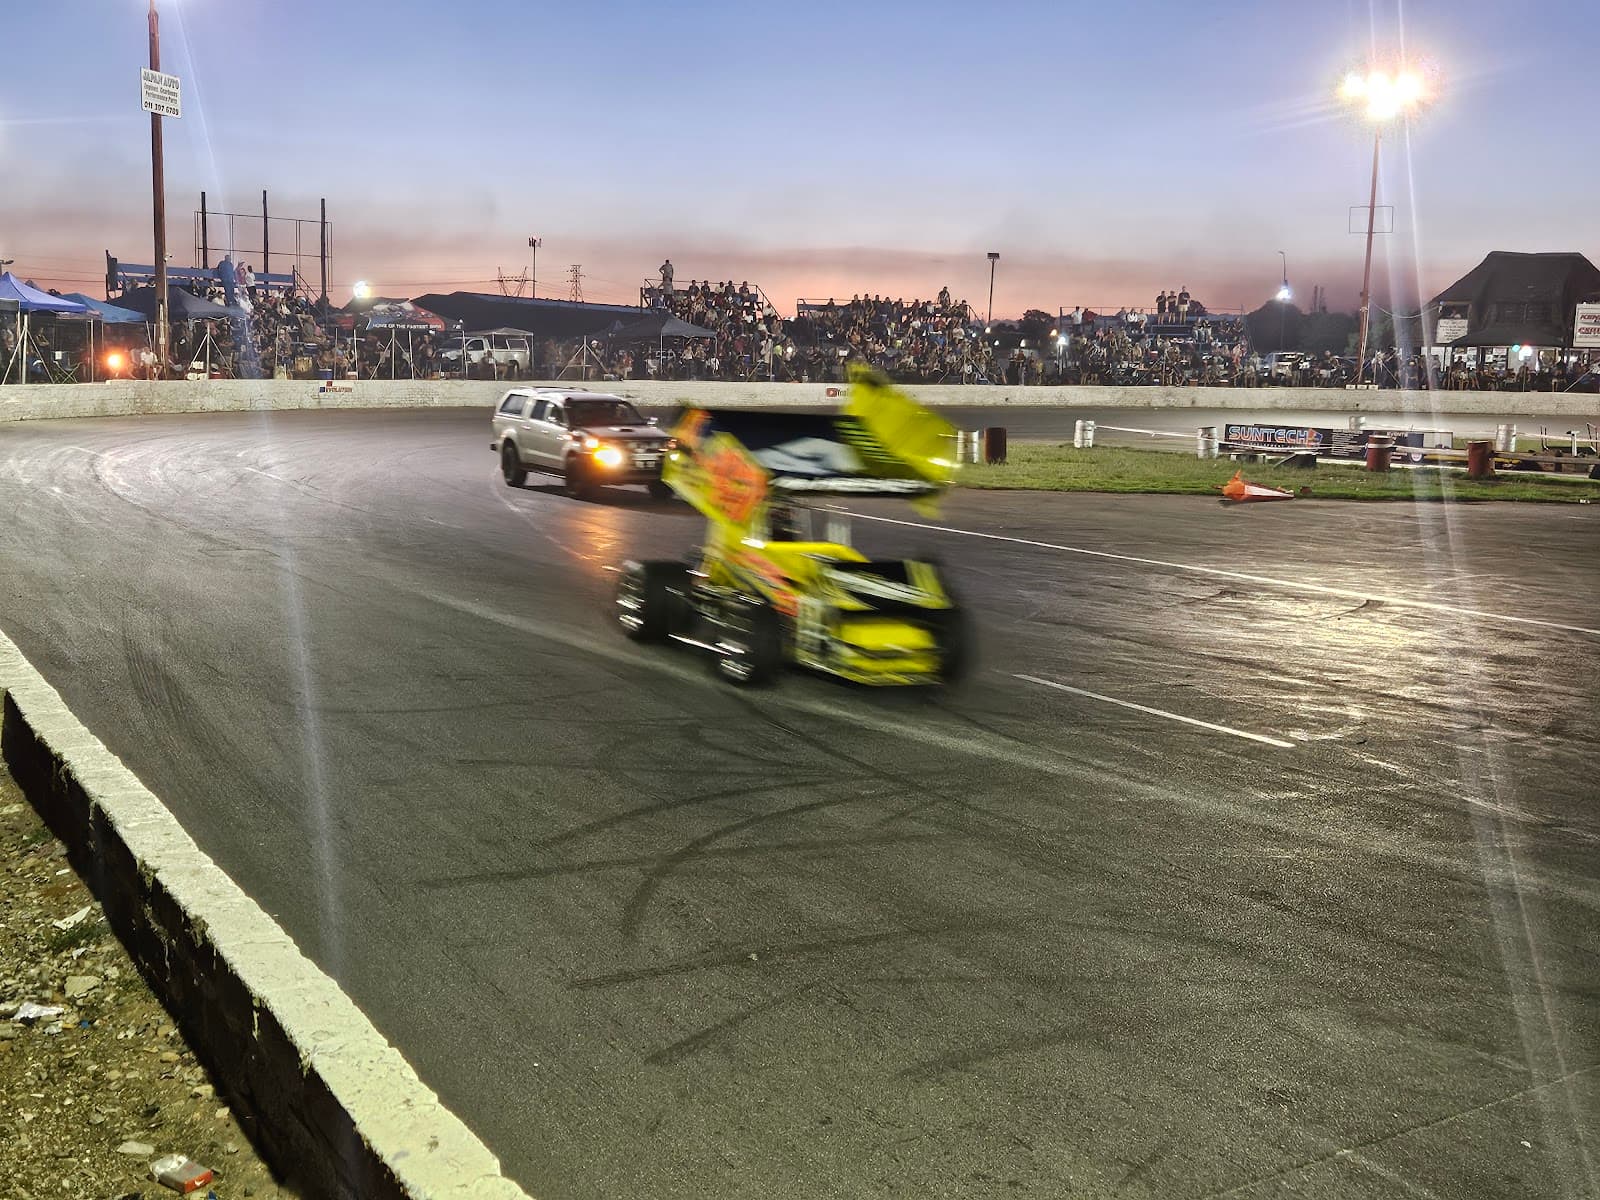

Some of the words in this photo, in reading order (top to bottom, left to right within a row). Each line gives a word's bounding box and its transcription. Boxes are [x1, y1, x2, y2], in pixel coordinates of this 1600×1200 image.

[164, 77, 179, 90] AUTO
[144, 101, 153, 109] 011
[1228, 425, 1308, 444] SUNTECH
